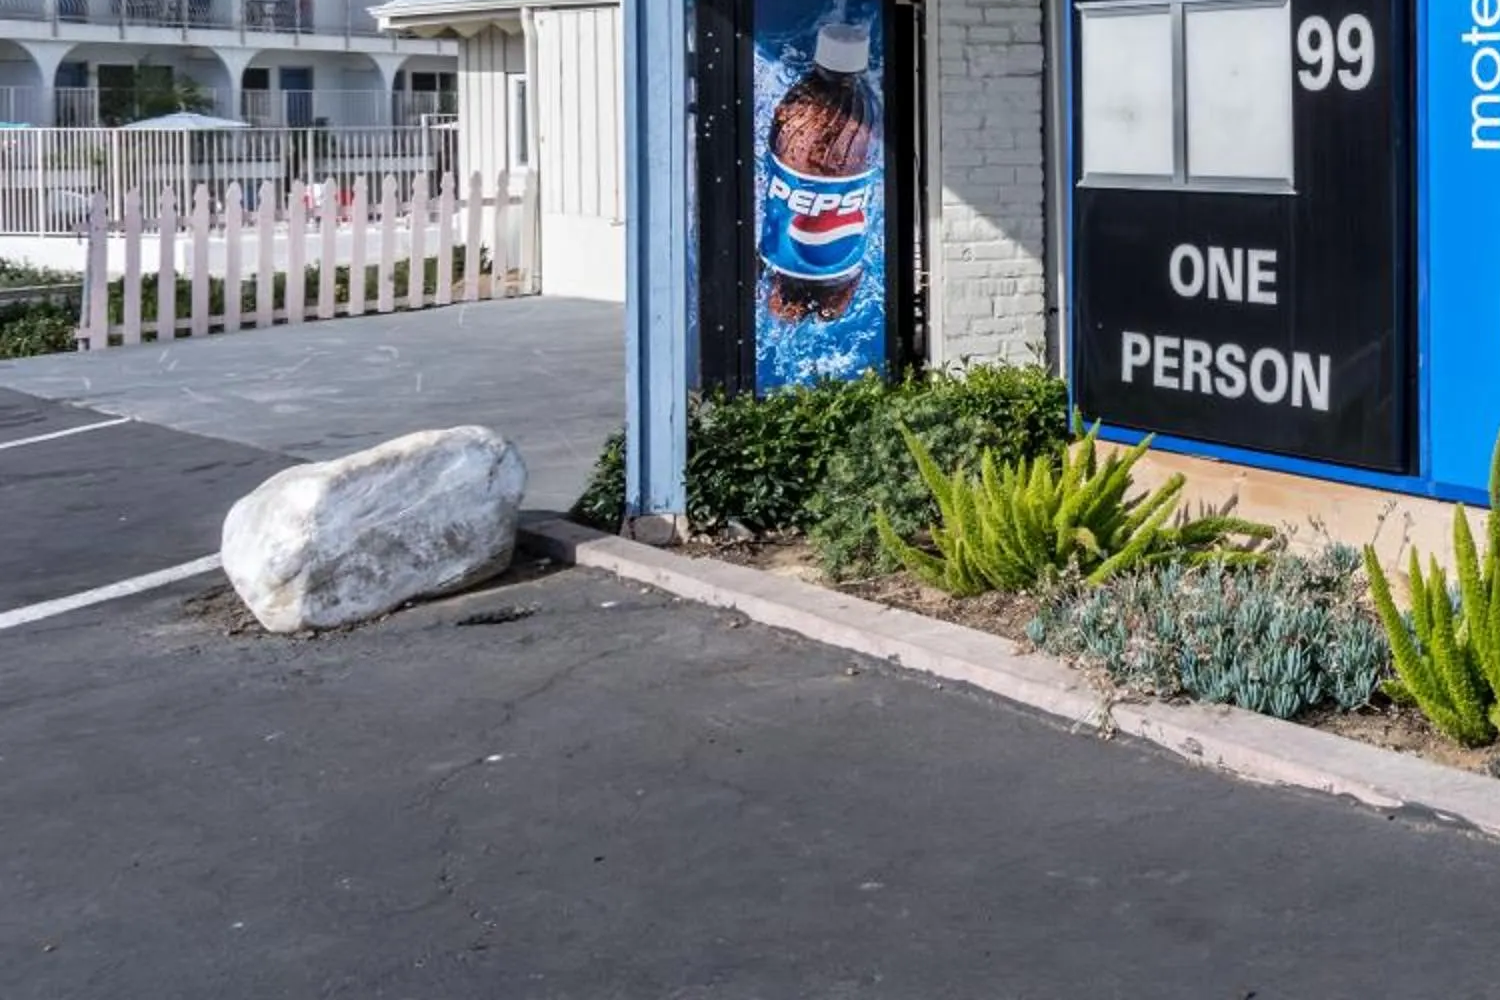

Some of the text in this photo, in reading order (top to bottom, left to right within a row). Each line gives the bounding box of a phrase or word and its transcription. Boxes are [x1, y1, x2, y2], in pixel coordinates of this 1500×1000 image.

[1297, 14, 1376, 91] 99
[768, 176, 872, 217] PEPSI
[1169, 243, 1278, 305] ONE
[1121, 331, 1331, 412] PERSON
